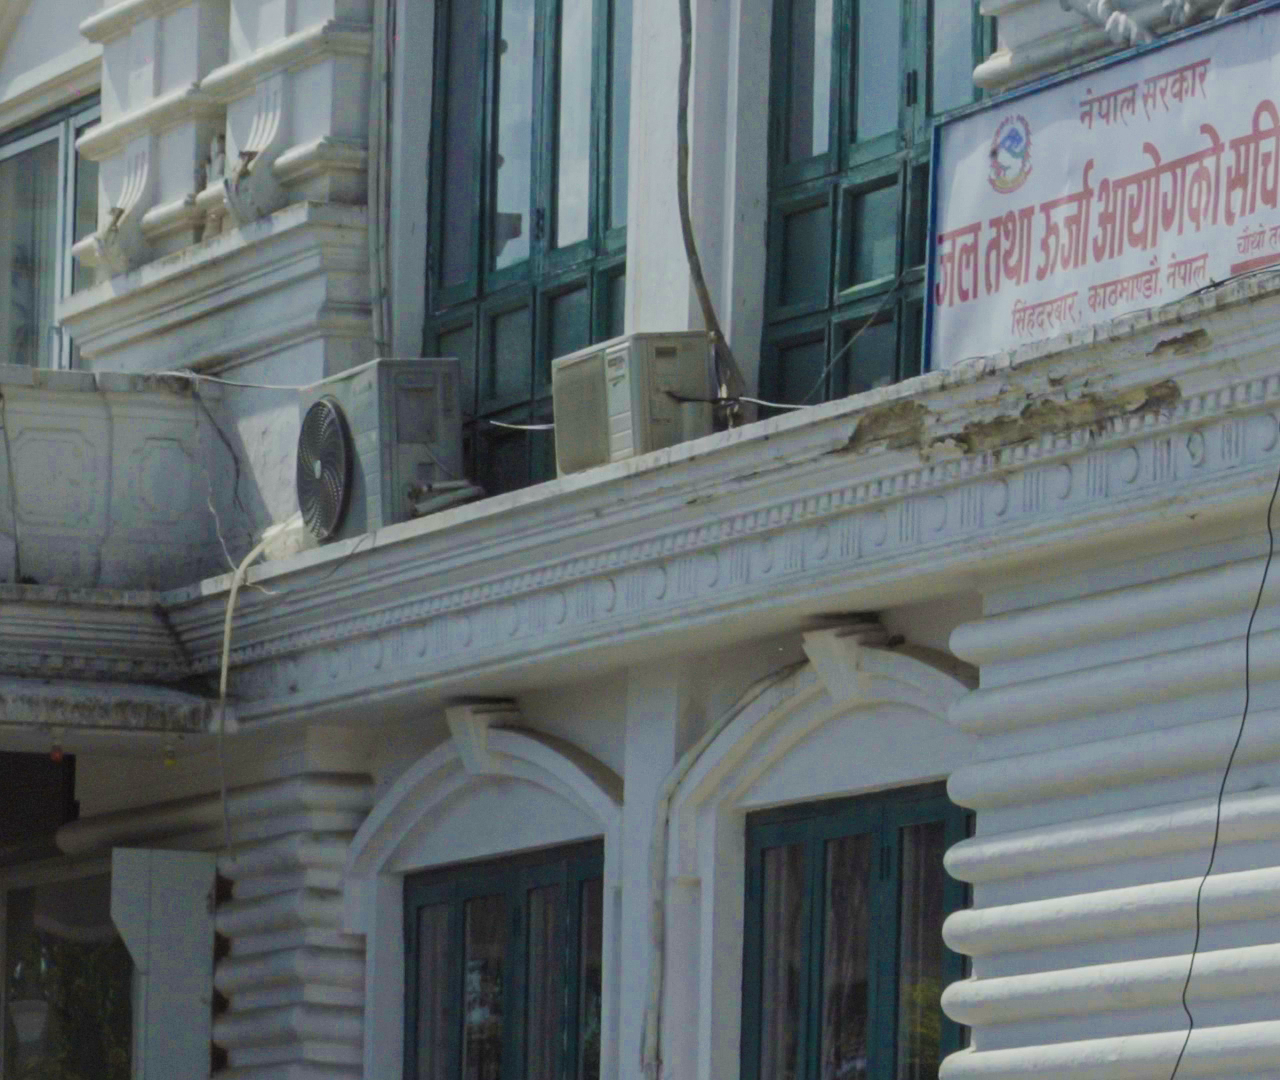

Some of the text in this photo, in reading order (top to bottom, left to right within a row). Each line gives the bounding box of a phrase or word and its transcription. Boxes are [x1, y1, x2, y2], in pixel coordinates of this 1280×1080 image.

[1079, 58, 1211, 129] नेपाल सरकार
[935, 221, 982, 307] जल
[985, 205, 1035, 293] तथा
[1036, 158, 1094, 281] ऊर्जा
[1092, 123, 1225, 263] आयोगको
[1167, 252, 1209, 289] नेपाल
